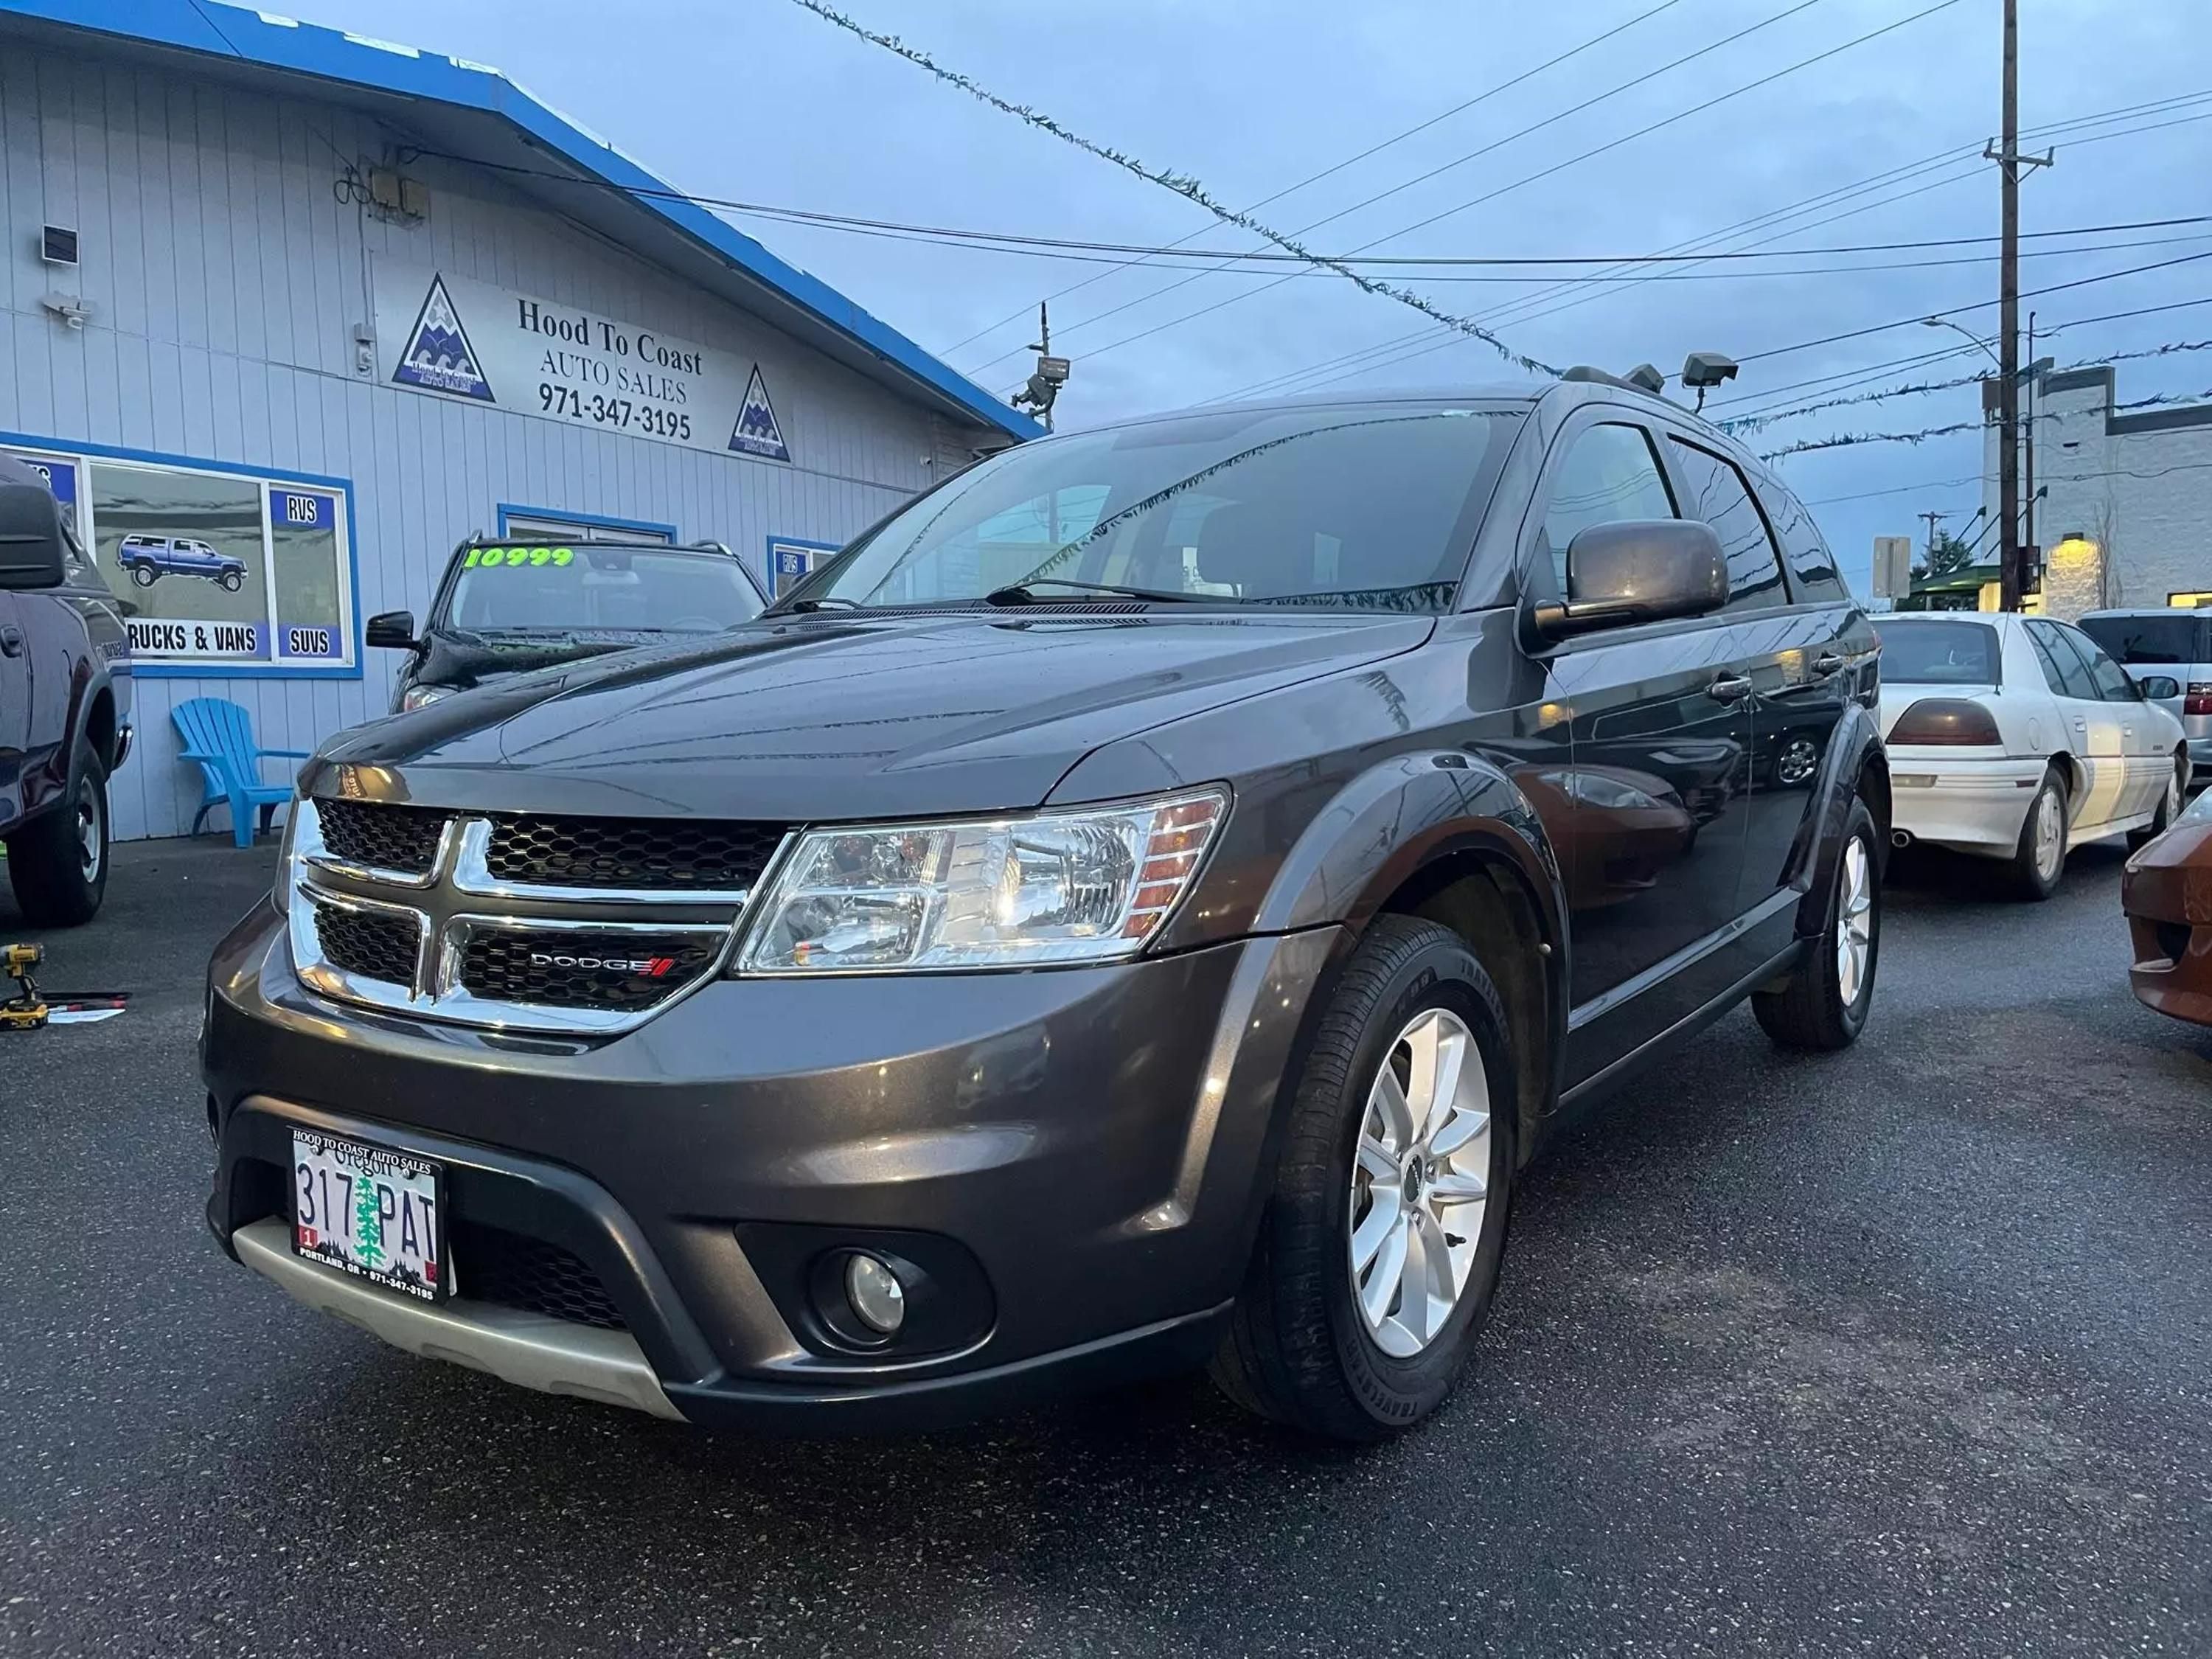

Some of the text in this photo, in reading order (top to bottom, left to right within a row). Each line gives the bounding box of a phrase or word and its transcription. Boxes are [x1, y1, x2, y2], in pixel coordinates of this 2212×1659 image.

[517, 299, 702, 375] Hood To Coast
[540, 349, 687, 404] AUTO SALES
[540, 383, 691, 440] 971-347-3195
[288, 497, 316, 522] RVS
[464, 548, 574, 567] 10999
[128, 624, 186, 650] RUCKS
[195, 626, 209, 650] &
[215, 627, 257, 651] VANS
[291, 629, 330, 653] SUVS
[530, 953, 653, 972] DODGE
[293, 1130, 431, 1175] HOOD TO COAST AUTO SALES
[297, 1163, 434, 1262] 317 PAT
[299, 1248, 346, 1270] PORTLAND,
[347, 1262, 361, 1275] OR
